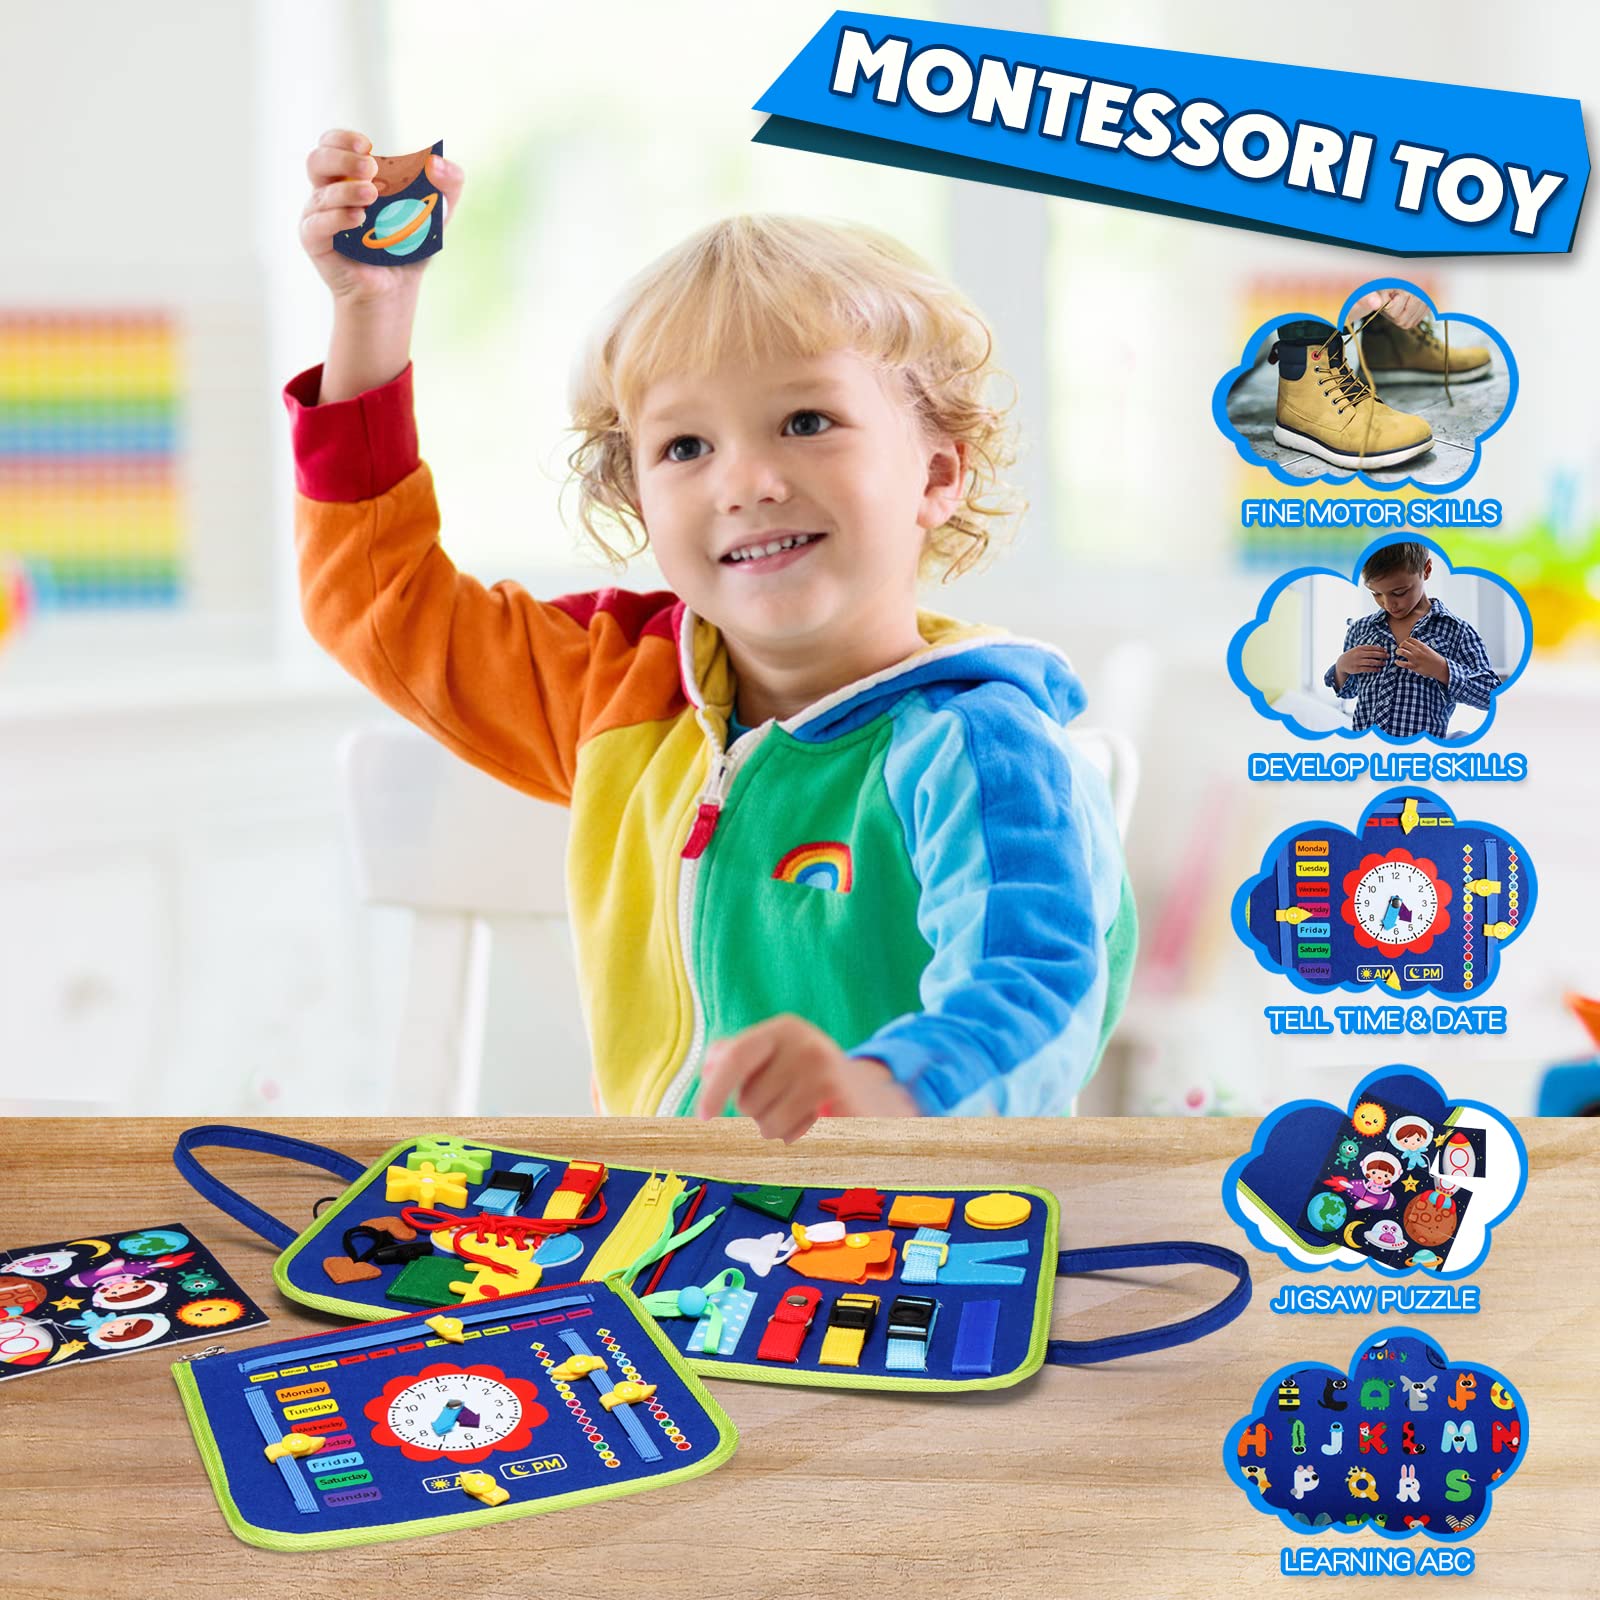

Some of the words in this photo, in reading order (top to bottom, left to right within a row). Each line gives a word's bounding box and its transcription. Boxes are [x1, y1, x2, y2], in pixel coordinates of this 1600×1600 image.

[1297, 844, 1328, 854] Monday
[1298, 864, 1328, 873] Tuesday
[1378, 875, 1384, 883] 11
[1391, 872, 1400, 880] 12
[1408, 875, 1412, 883] 1
[1368, 885, 1376, 893] 10
[1418, 885, 1424, 893] 2
[1364, 899, 1370, 907] 9
[1369, 914, 1375, 922] 8
[1300, 926, 1328, 935] Friday
[1408, 924, 1414, 932] 5
[1300, 946, 1329, 954] Saturday
[1300, 966, 1330, 975] Sunday
[1373, 968, 1392, 979] AM
[1423, 967, 1440, 979] PM
[280, 1385, 326, 1399] Monday
[435, 1384, 449, 1393] 12
[1447, 1373, 1477, 1411] F
[416, 1392, 426, 1401] 11
[494, 1399, 503, 1407] 3
[287, 1403, 333, 1416] Tuesday
[405, 1404, 418, 1413] 10
[405, 1418, 415, 1426] 9
[484, 1424, 494, 1432] 5
[419, 1429, 428, 1437] 8
[463, 1432, 473, 1441] 6
[1237, 1422, 1272, 1457] H
[1321, 1421, 1344, 1455] J
[1359, 1421, 1389, 1455] K
[1402, 1421, 1426, 1455] L
[1440, 1420, 1478, 1453] M
[1491, 1420, 1521, 1453] N
[312, 1456, 357, 1469] Friday
[531, 1457, 562, 1473] PM
[319, 1472, 368, 1486] Saturday
[1290, 1465, 1320, 1500] P
[1345, 1466, 1380, 1502] Q
[1396, 1464, 1420, 1502] R
[1444, 1469, 1476, 1502] S
[327, 1490, 377, 1503] Sunday
